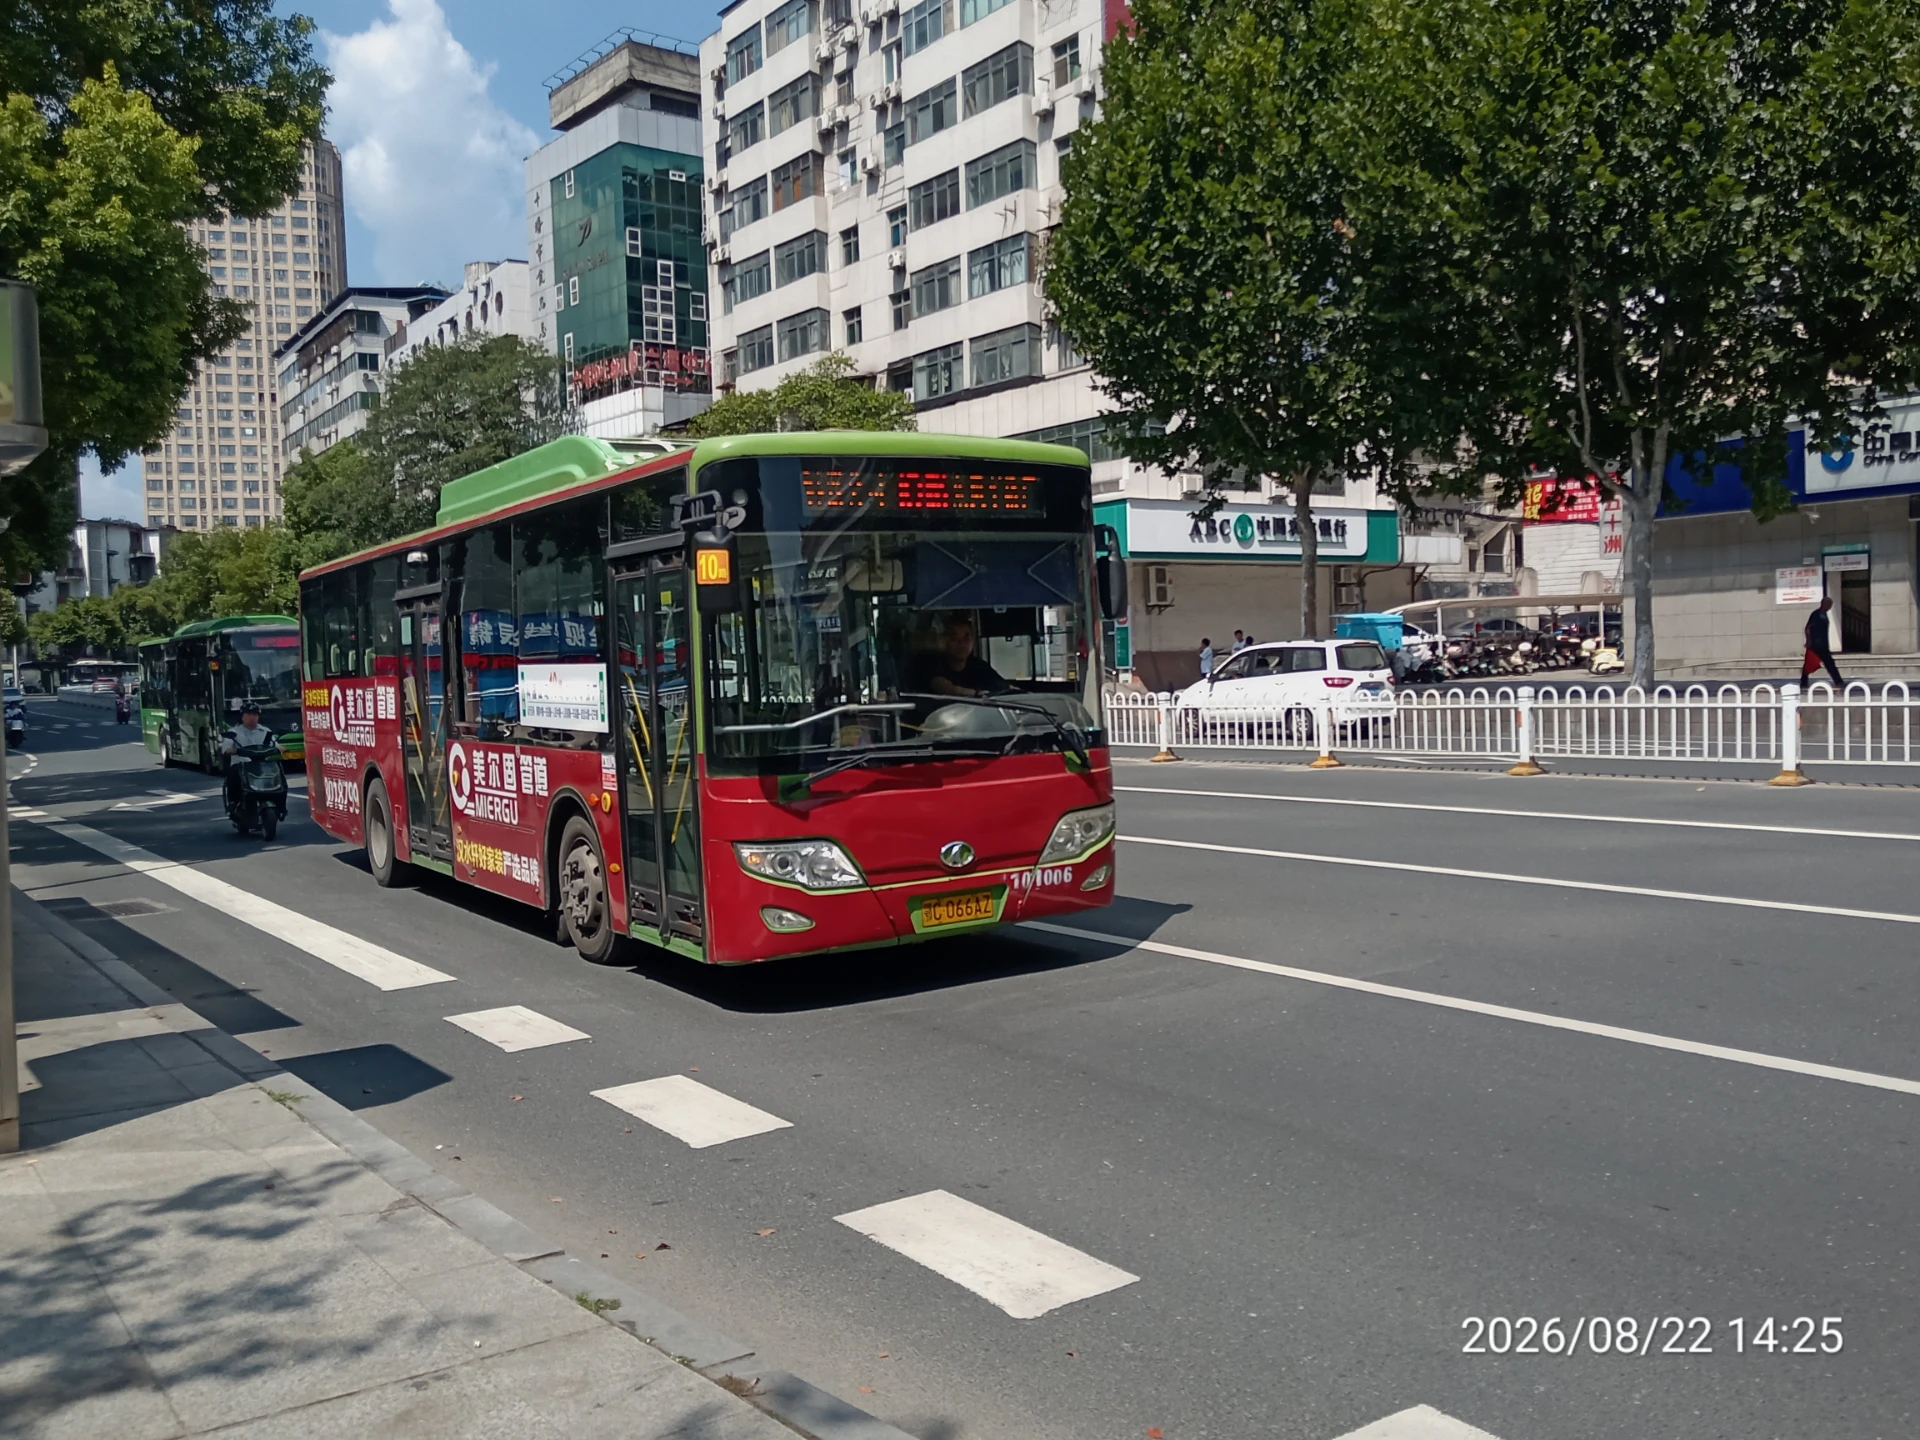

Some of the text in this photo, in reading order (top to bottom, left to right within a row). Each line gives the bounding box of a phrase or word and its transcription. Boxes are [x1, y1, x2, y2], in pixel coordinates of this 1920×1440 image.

[1863, 429, 1920, 454] 中国
[1189, 518, 1231, 537] ABC
[1256, 516, 1347, 538] 中国农银行
